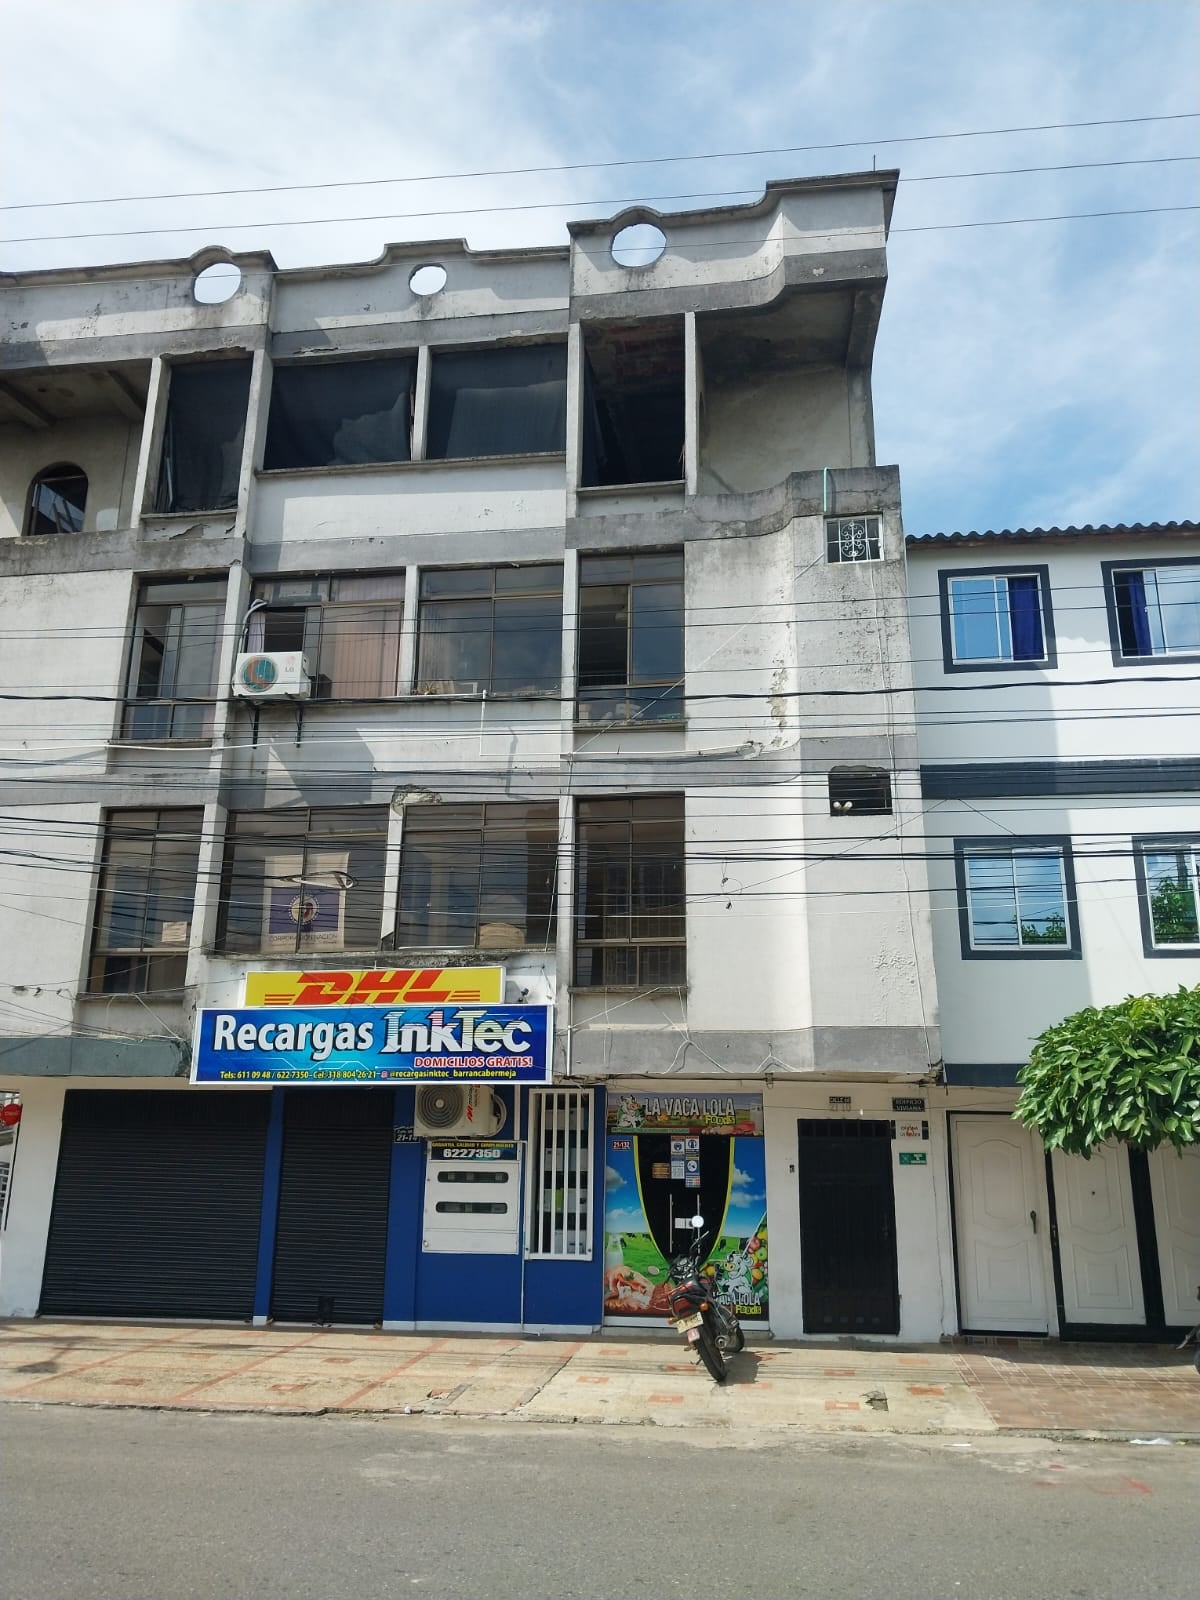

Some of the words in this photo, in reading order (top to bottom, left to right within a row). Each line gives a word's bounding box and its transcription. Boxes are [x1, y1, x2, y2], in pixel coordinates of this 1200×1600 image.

[292, 970, 450, 1005] DHL
[213, 1015, 373, 1060] Recargas
[381, 1010, 532, 1053] InkTec
[414, 1057, 483, 1068] DOMICILIOS
[485, 1056, 533, 1067] GRATIS!
[220, 1071, 236, 1079] Tels:
[237, 1070, 250, 1079] 611
[251, 1070, 260, 1079] 09
[261, 1070, 271, 1079] 48
[276, 1070, 289, 1079] 622
[291, 1069, 309, 1078] 7350
[327, 1069, 341, 1078] 318
[342, 1069, 356, 1078] 804
[645, 1098, 661, 1116] LA
[664, 1098, 700, 1116] VACA
[703, 1098, 735, 1116] LOLA
[443, 1149, 500, 1158] 6227350
[739, 1293, 760, 1305] LOLA
